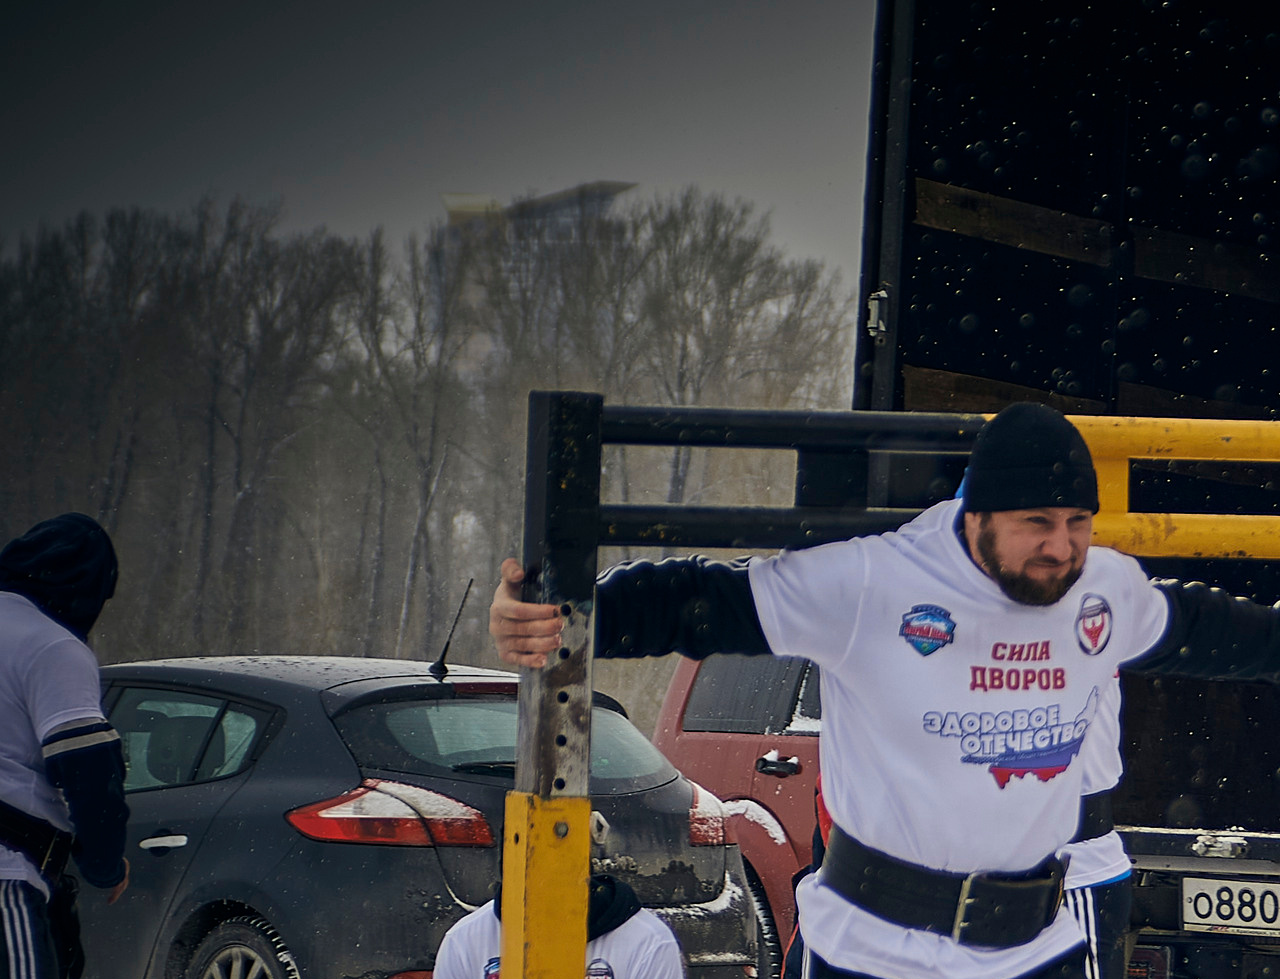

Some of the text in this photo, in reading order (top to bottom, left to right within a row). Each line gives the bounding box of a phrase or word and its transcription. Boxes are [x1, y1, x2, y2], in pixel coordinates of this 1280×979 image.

[991, 640, 1051, 662] СИЛА
[970, 666, 1066, 692] ДВОРОВ
[923, 704, 1061, 738] ЗДОРОВОЕ
[960, 718, 1090, 756] ОТЕЧЕСТВО
